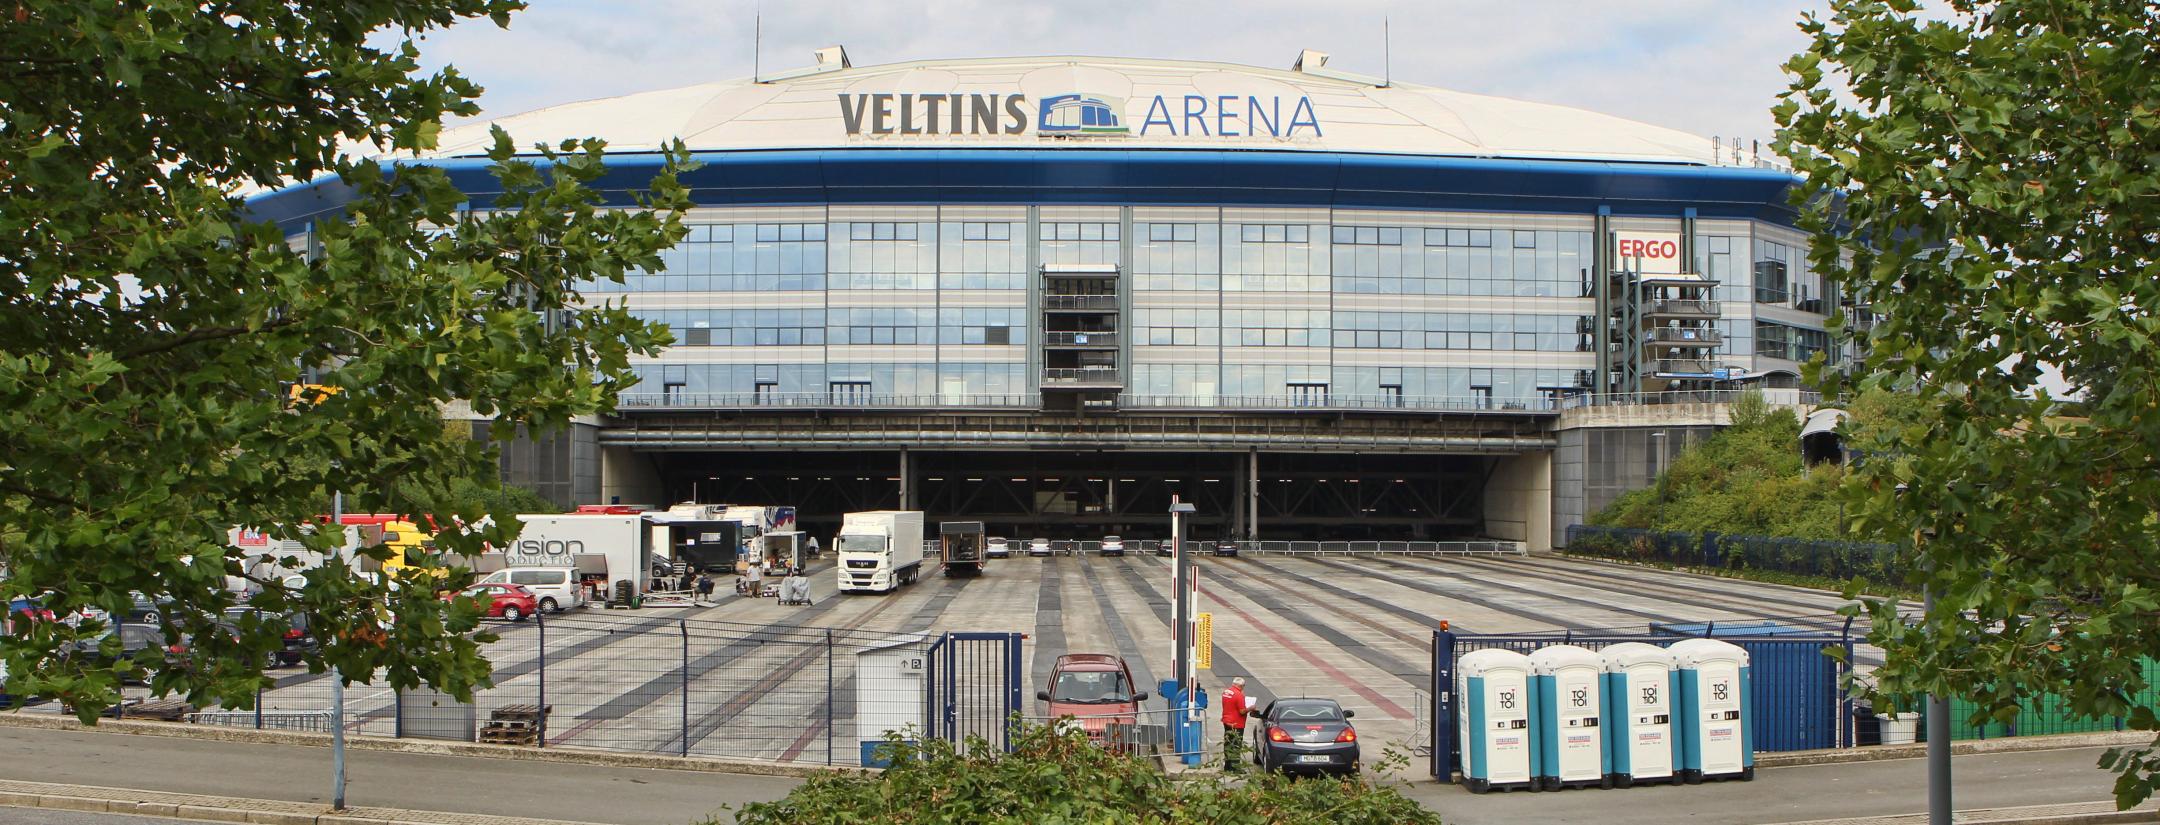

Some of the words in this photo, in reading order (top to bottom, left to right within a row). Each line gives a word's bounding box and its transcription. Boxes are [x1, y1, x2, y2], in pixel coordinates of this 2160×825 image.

[838, 93, 1028, 135] VELTINS
[1140, 95, 1323, 138] ARENA
[1619, 239, 1677, 259] ERGO
